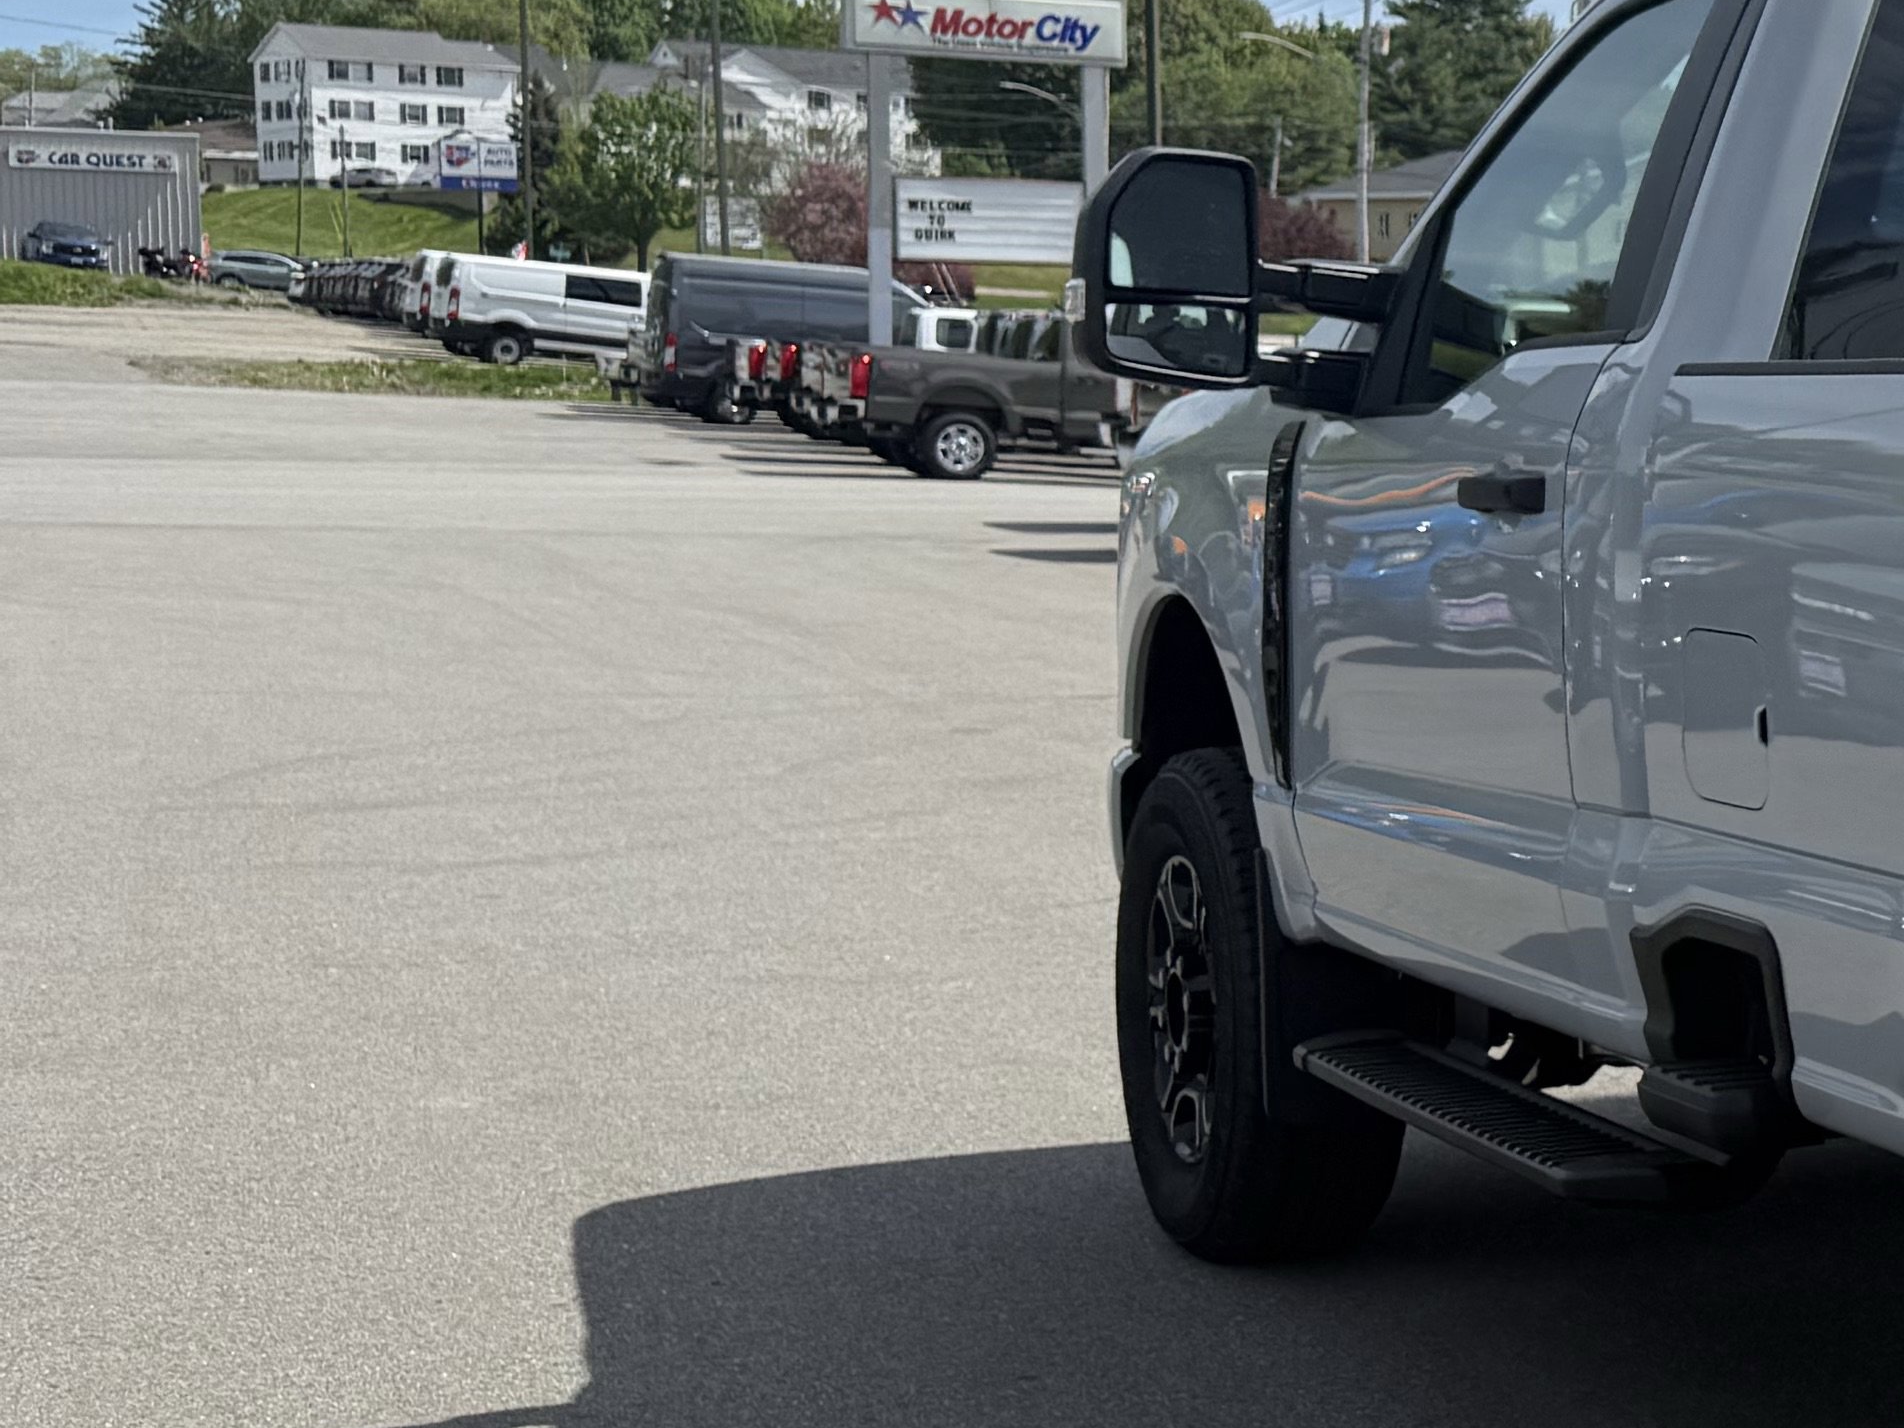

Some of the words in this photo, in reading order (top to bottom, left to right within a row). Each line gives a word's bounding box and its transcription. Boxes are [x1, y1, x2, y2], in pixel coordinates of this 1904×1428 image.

[931, 7, 1100, 52] MotorCity
[48, 151, 80, 165] CAR
[85, 152, 146, 168] QUEST
[908, 198, 973, 212] WELCOME
[928, 214, 946, 228] TO
